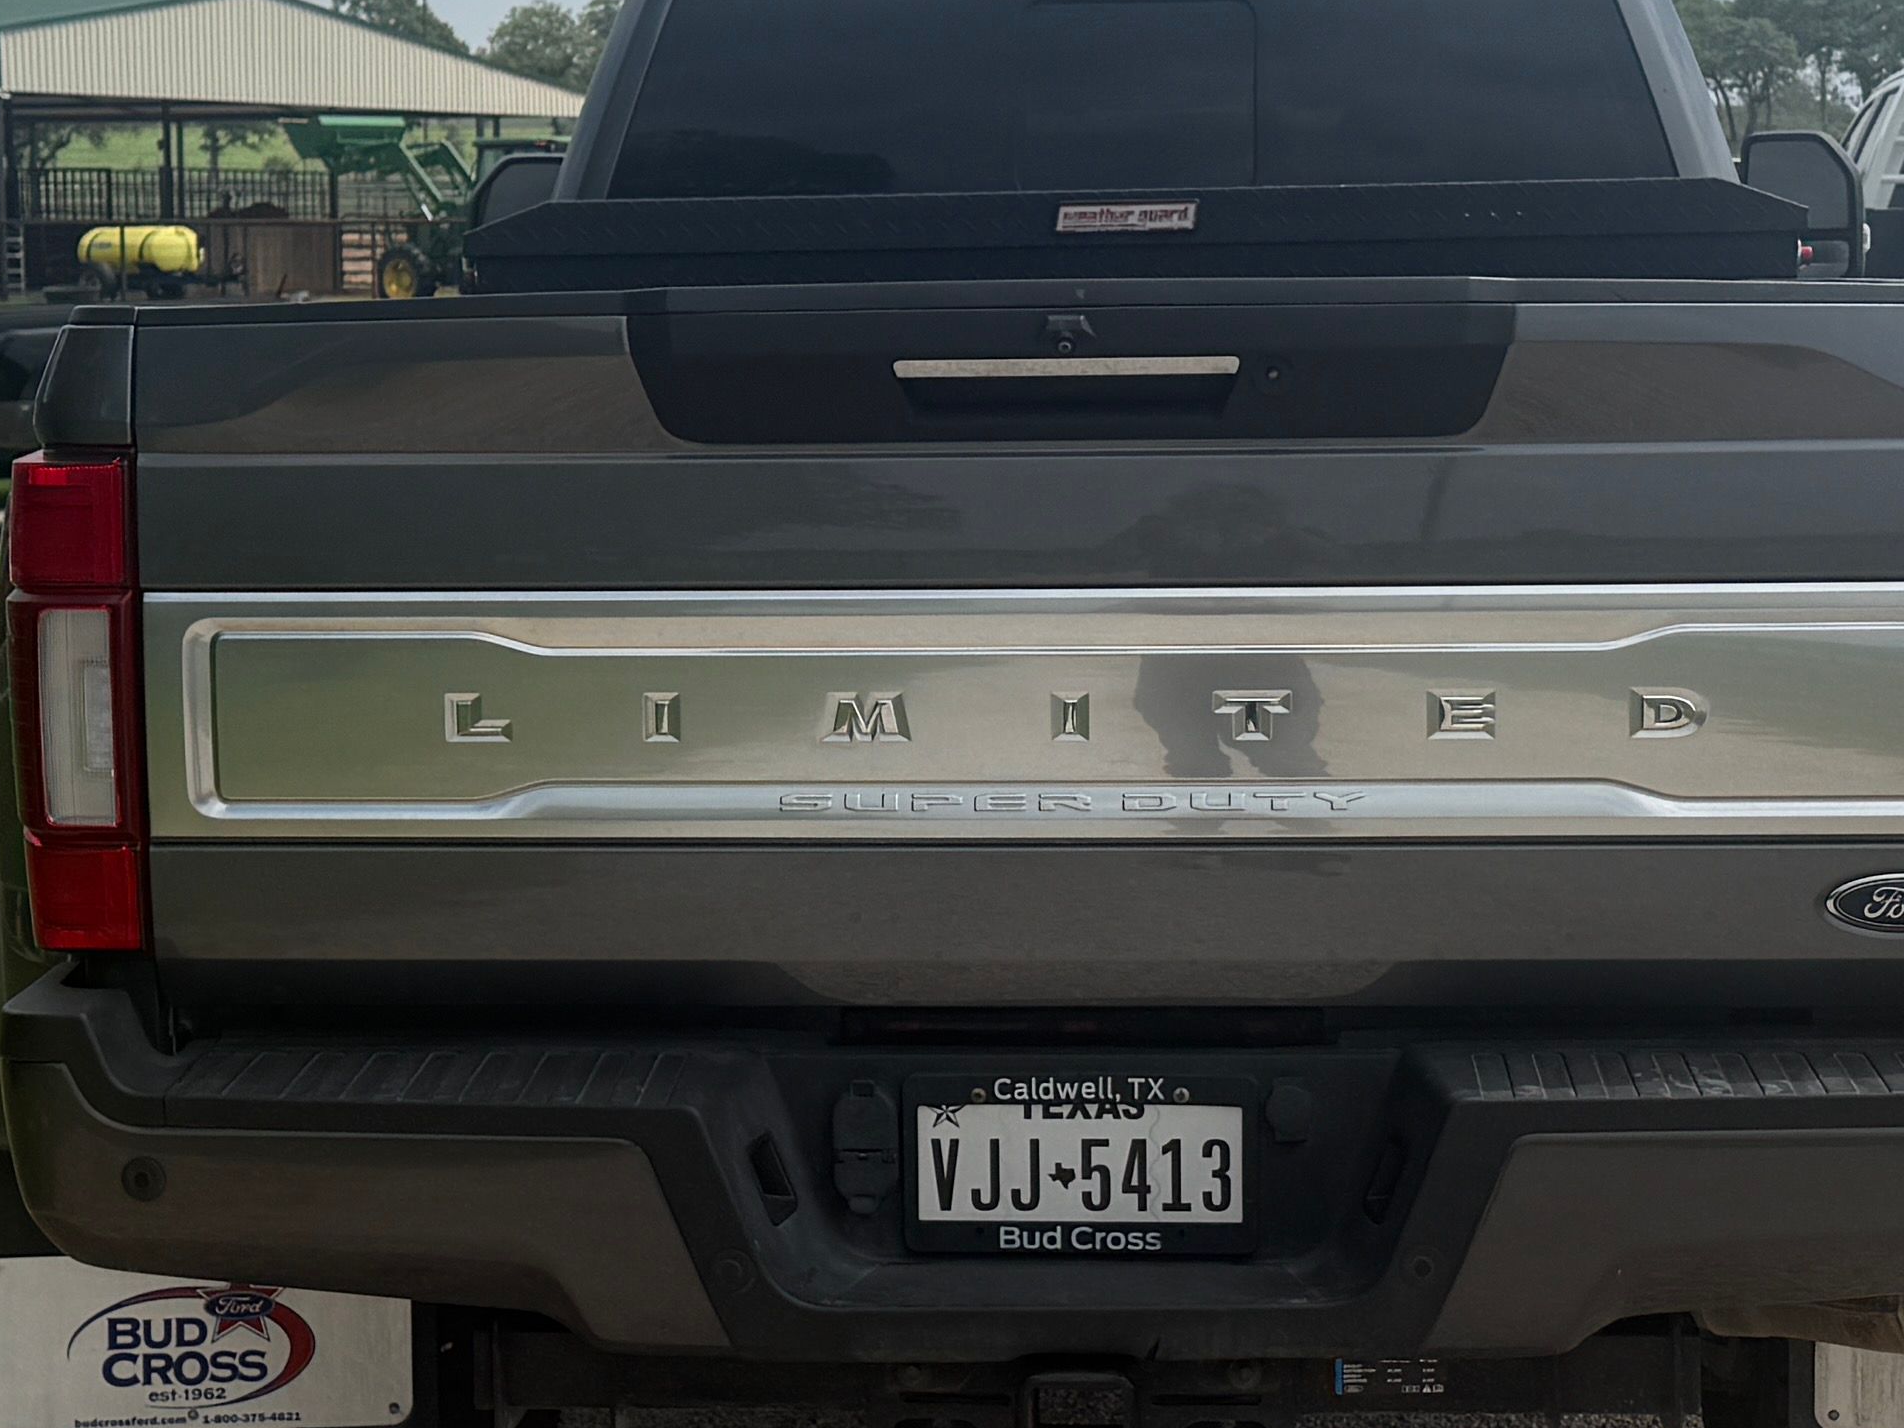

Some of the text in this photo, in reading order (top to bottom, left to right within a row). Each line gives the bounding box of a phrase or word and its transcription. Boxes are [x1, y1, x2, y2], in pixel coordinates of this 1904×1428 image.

[444, 687, 1707, 744] LIMITED
[779, 790, 1366, 813] SUPER DUTY
[993, 1077, 1165, 1101] Caldwell, TX
[999, 1226, 1162, 1250] Bud Cross
[215, 1296, 265, 1315] Ford
[106, 1317, 208, 1350] BUD
[102, 1350, 269, 1387] CROSS
[74, 1416, 187, 1428] budcrossford.com
